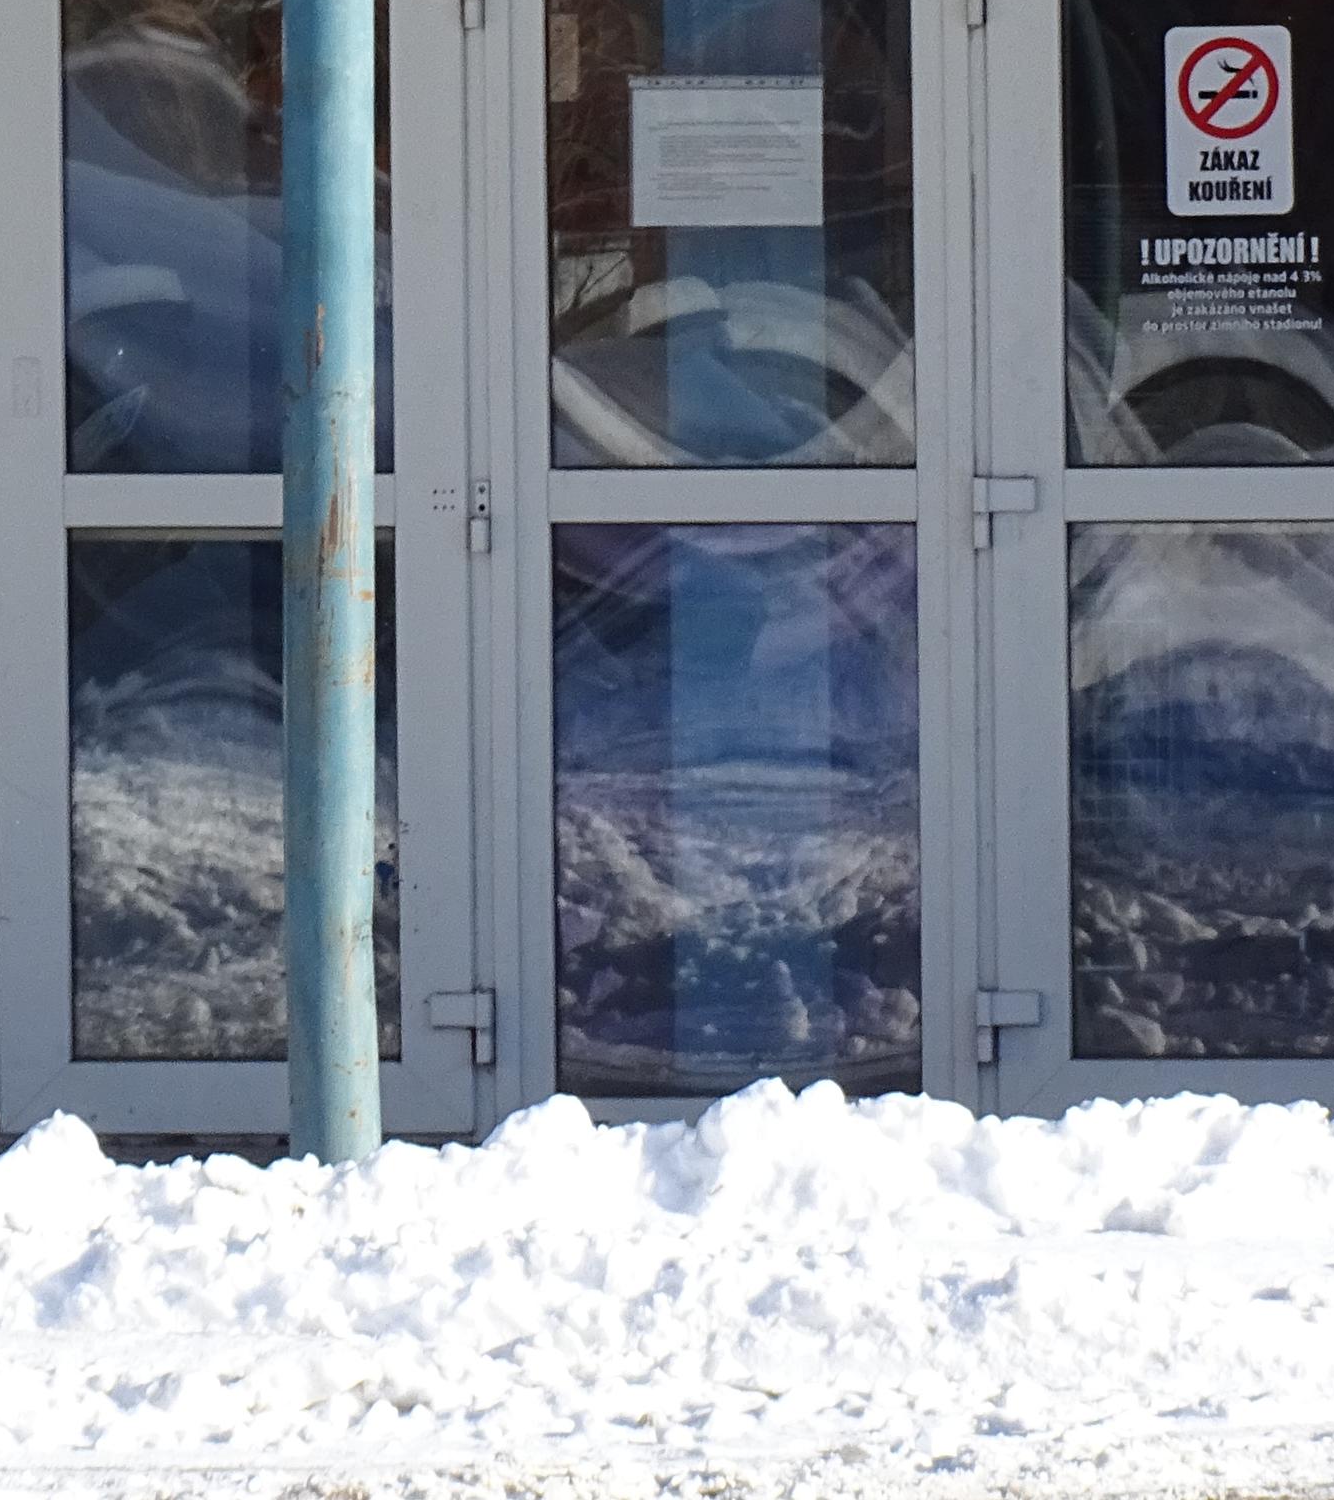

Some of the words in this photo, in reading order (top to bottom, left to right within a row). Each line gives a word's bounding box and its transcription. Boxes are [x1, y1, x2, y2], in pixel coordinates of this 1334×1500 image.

[1199, 147, 1260, 172] ZÁKAZ
[1188, 176, 1273, 202] KOUŘENÍ
[1155, 231, 1305, 266] UPOZORNĚNÍ
[1140, 271, 1214, 285] Alkoholické
[1217, 271, 1260, 286] nápoje
[1262, 270, 1288, 284] nad
[1166, 287, 1245, 302] objemového
[1248, 285, 1297, 299] etanolu
[1171, 302, 1184, 318] je
[1141, 320, 1158, 332] do
